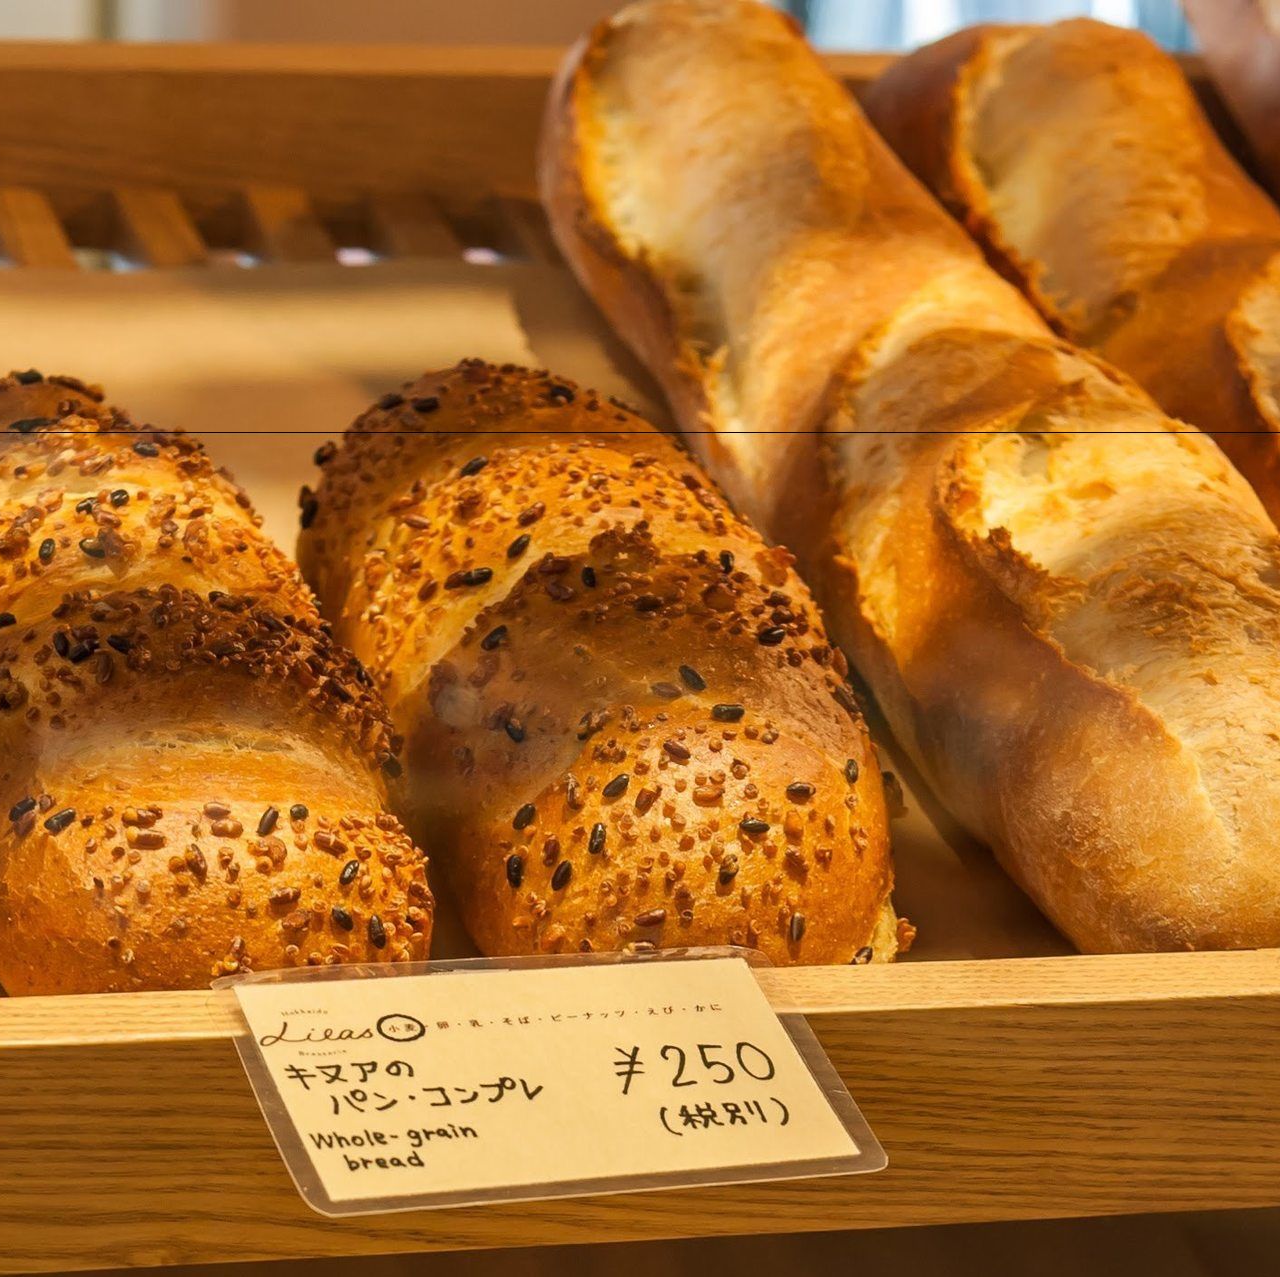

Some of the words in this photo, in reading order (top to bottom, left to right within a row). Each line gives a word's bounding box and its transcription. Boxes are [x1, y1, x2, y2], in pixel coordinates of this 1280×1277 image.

[284, 1060, 415, 1089] キヌアの
[613, 1041, 776, 1095] ¥250
[308, 1122, 478, 1150] Whole-grain
[343, 1151, 425, 1172] bread
